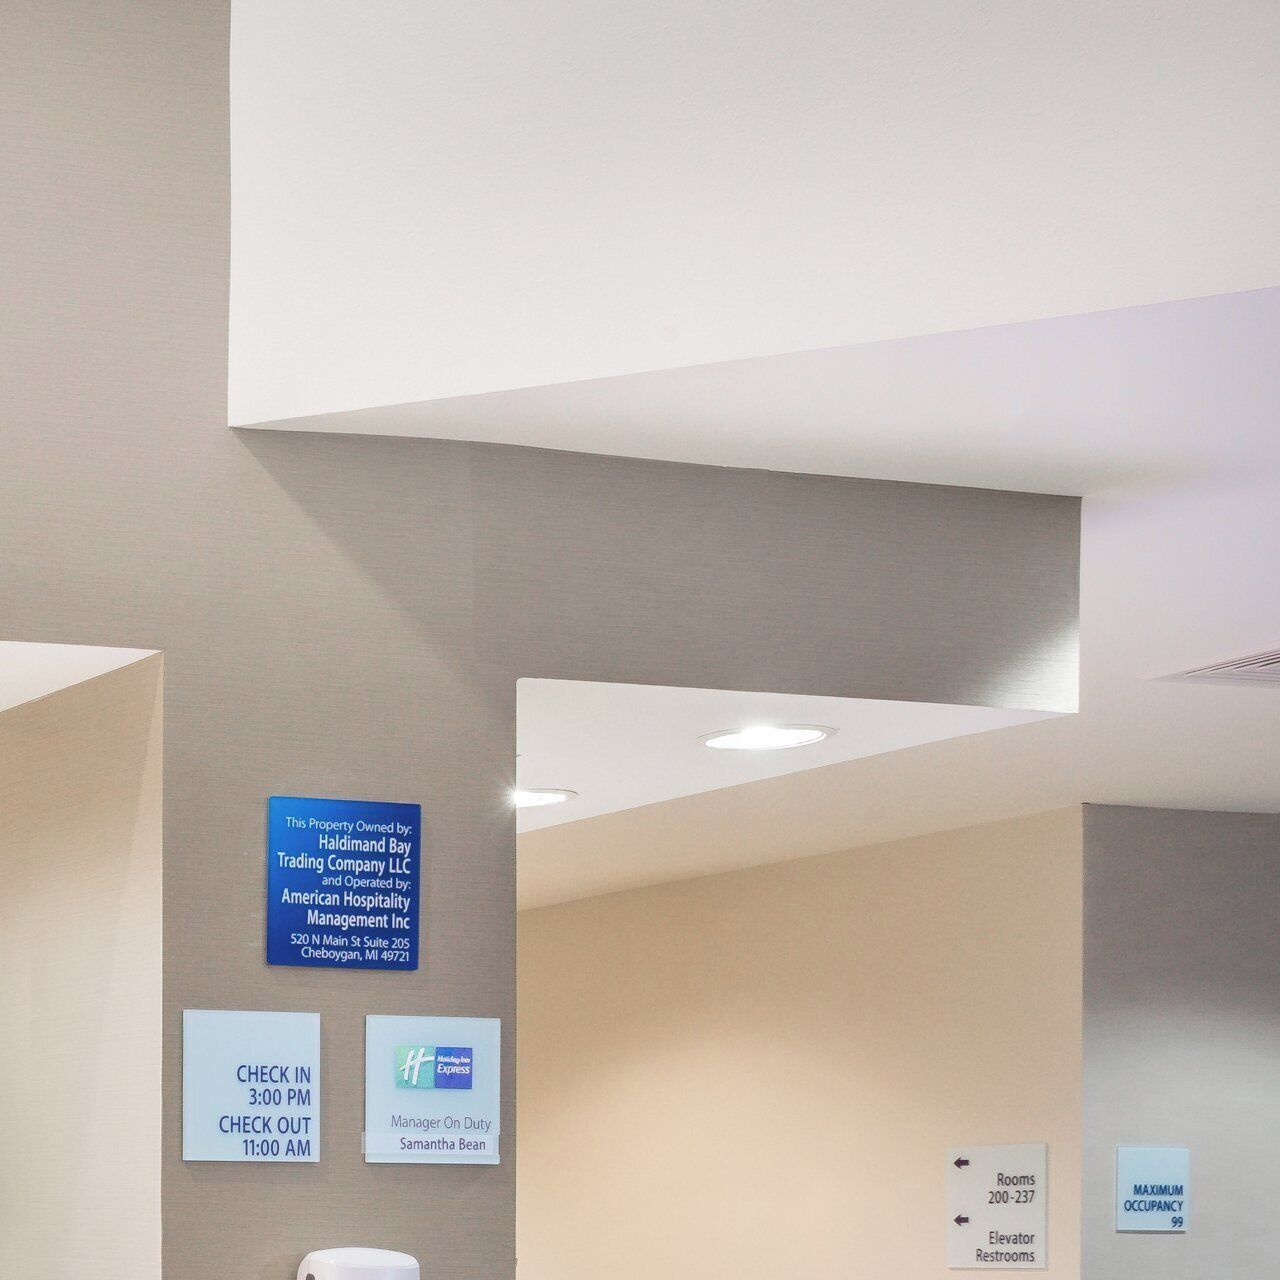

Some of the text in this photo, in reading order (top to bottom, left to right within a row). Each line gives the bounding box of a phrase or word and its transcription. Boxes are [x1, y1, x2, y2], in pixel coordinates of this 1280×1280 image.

[286, 816, 412, 836] This Property Owned by:
[319, 834, 411, 857] Haldimand Bay
[277, 852, 411, 876] Trading Company LLC
[322, 875, 411, 891] and Operated by:
[281, 888, 411, 913] American Hospitality
[307, 909, 410, 930] Management Inc
[290, 933, 410, 949] 520 N Main St Suite 205
[301, 947, 410, 962] Cheboygan, MI 49721
[437, 1055, 471, 1065] Holiday Inn
[236, 1064, 311, 1083] CHECK IN
[437, 1063, 471, 1075] Express
[248, 1088, 311, 1106] 3:00 PM
[219, 1115, 311, 1134] CHECK OUT
[391, 1115, 492, 1133] Manager On Duty
[242, 1139, 311, 1157] 11:00 AM
[399, 1137, 486, 1151] Samantha Bean
[997, 1172, 1036, 1186] Rooms
[1133, 1184, 1184, 1196] MAXIMUM
[1124, 1199, 1184, 1212] OCCUPANCY
[1171, 1216, 1184, 1228] 99
[989, 1230, 1035, 1245] Elevator
[975, 1248, 1035, 1262] Restrooms
